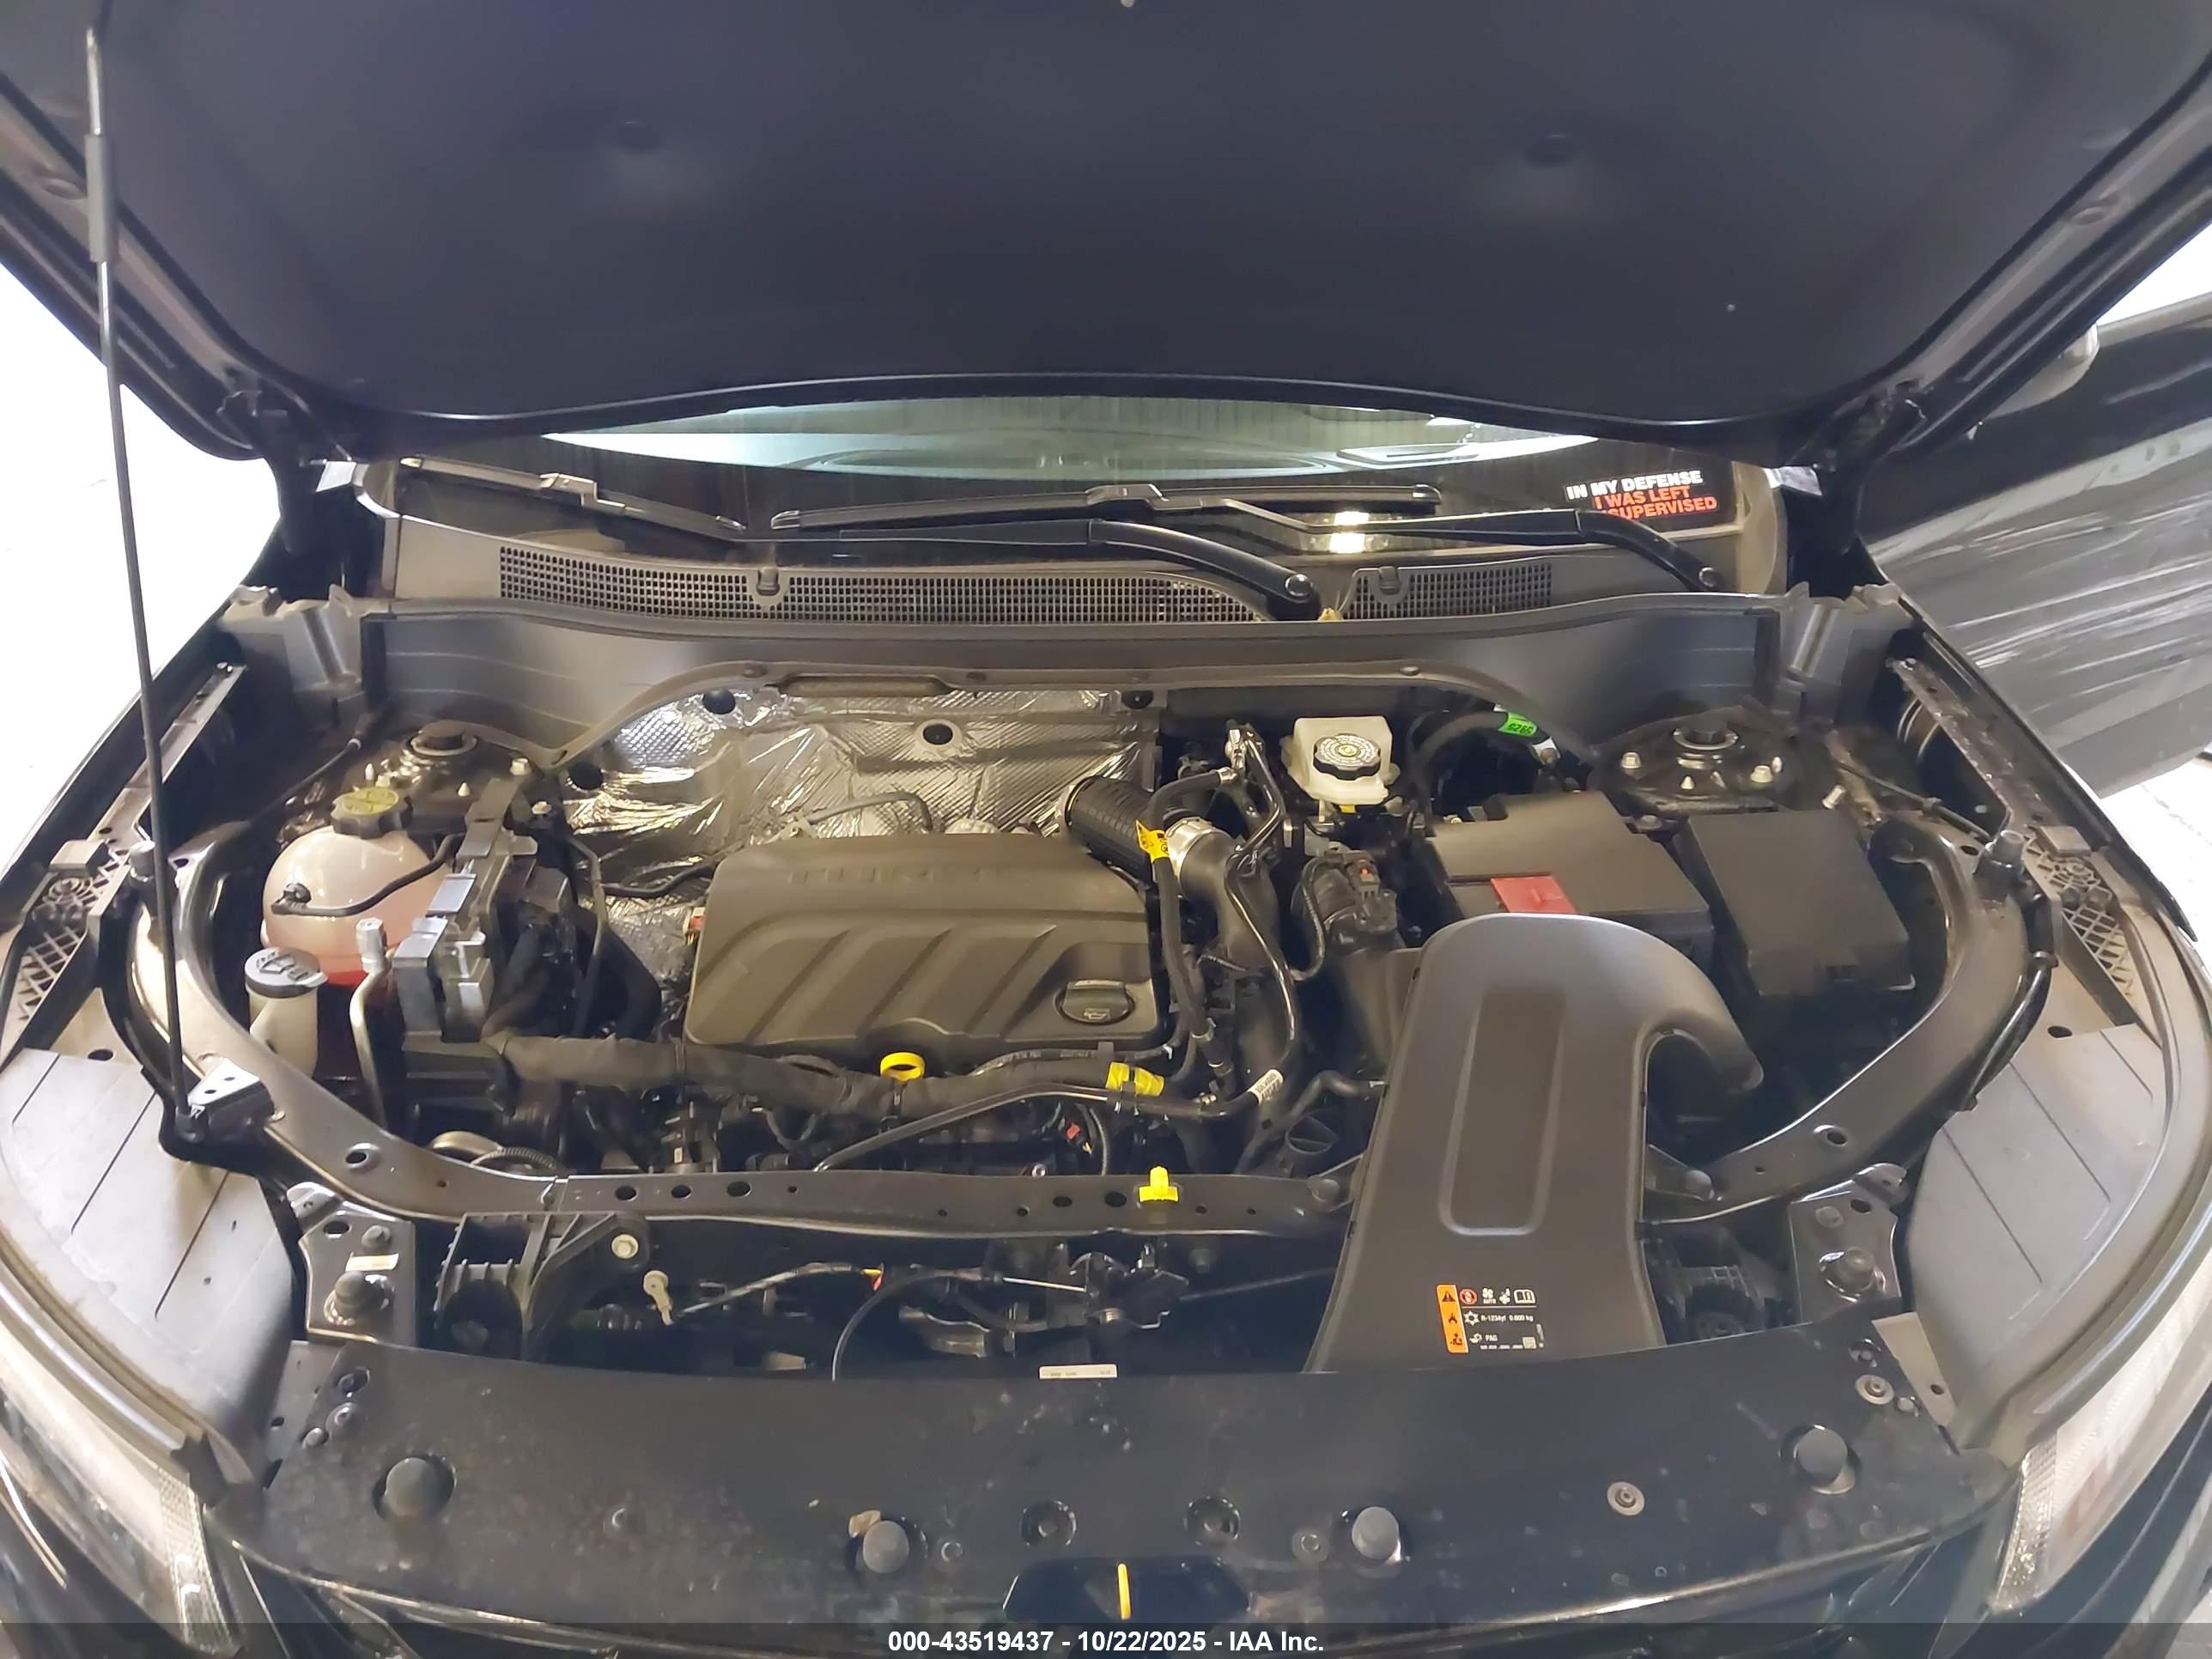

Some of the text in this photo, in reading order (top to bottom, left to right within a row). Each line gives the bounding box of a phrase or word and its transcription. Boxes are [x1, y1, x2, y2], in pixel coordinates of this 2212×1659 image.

[1566, 470, 1703, 500] IN MY DEFENSE
[1595, 485, 1690, 509] I WAS LEFT
[1602, 496, 1717, 519] SUPERVISED
